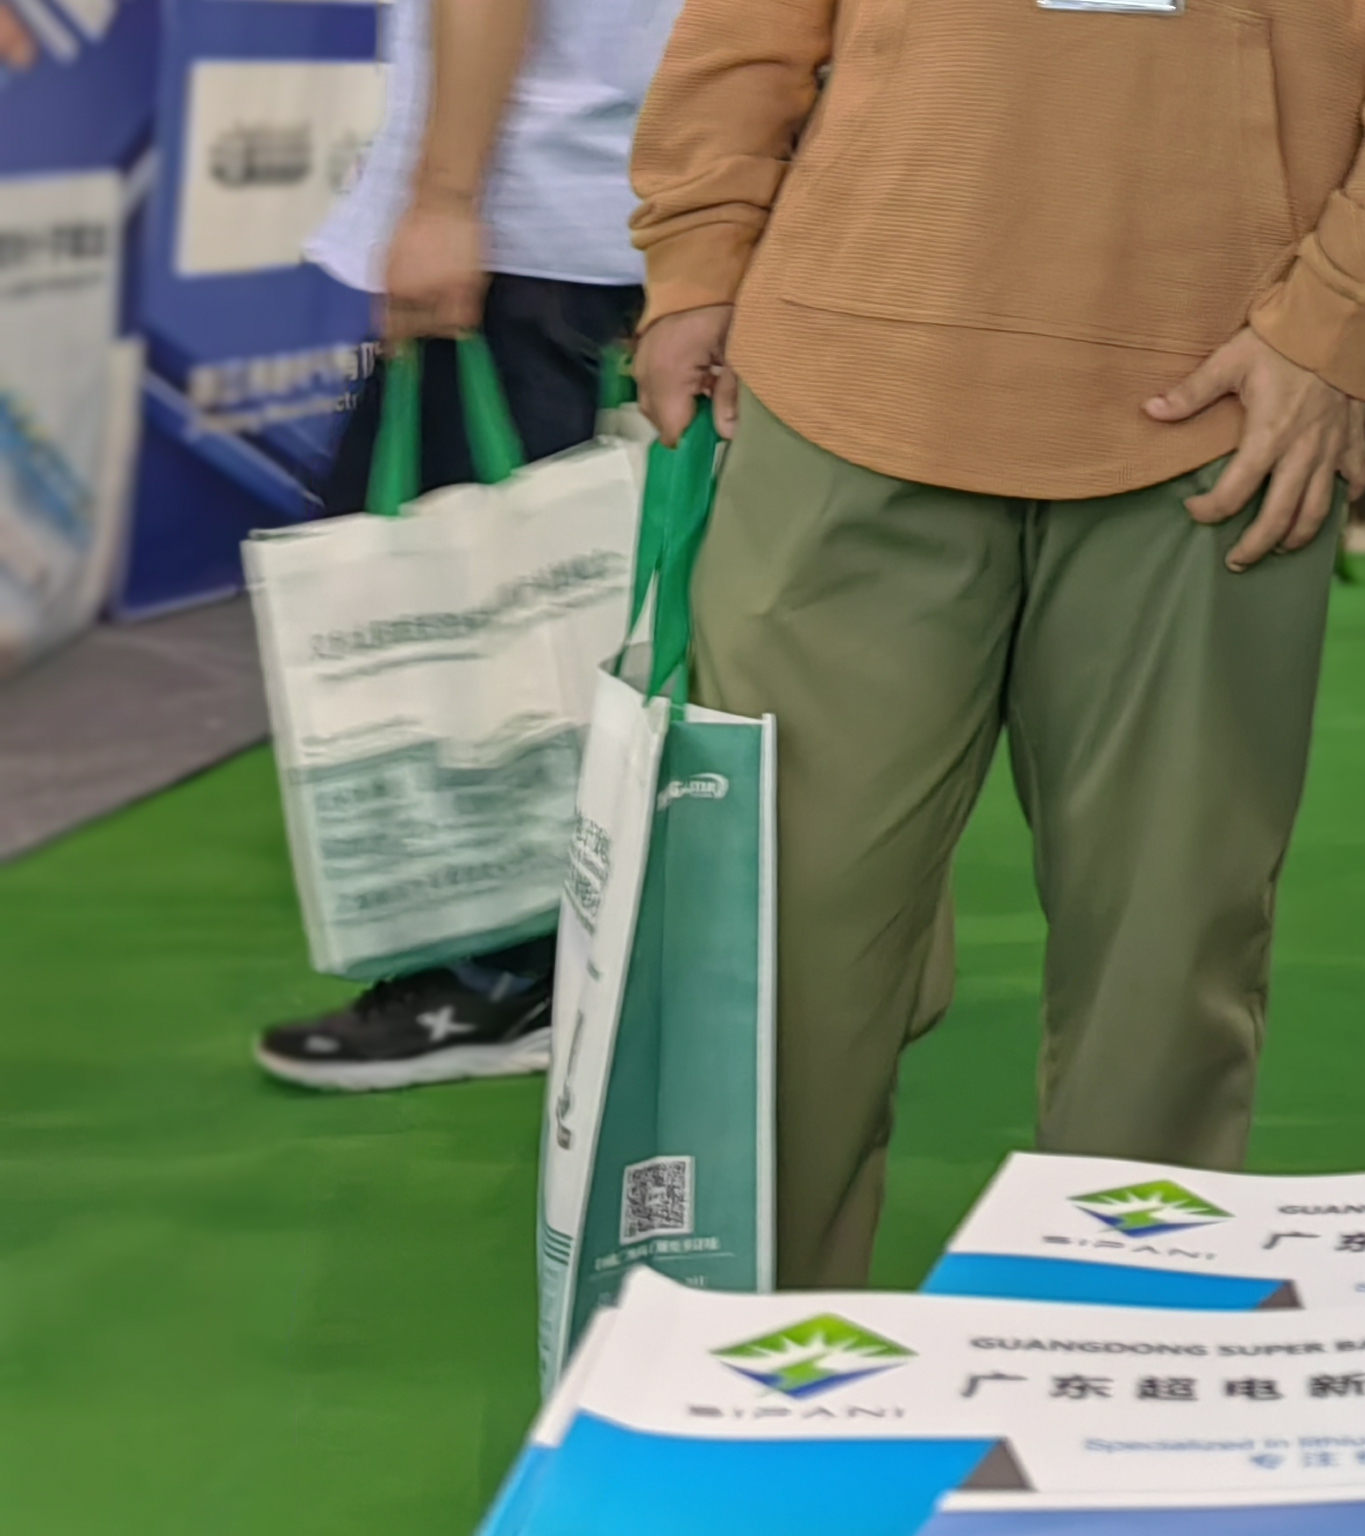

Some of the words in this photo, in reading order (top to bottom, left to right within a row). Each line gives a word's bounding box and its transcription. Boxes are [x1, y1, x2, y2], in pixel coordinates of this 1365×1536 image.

[969, 1335, 1208, 1356] GUANGDONG
[1217, 1341, 1326, 1356] SUPER
[1263, 1437, 1289, 1449] in
